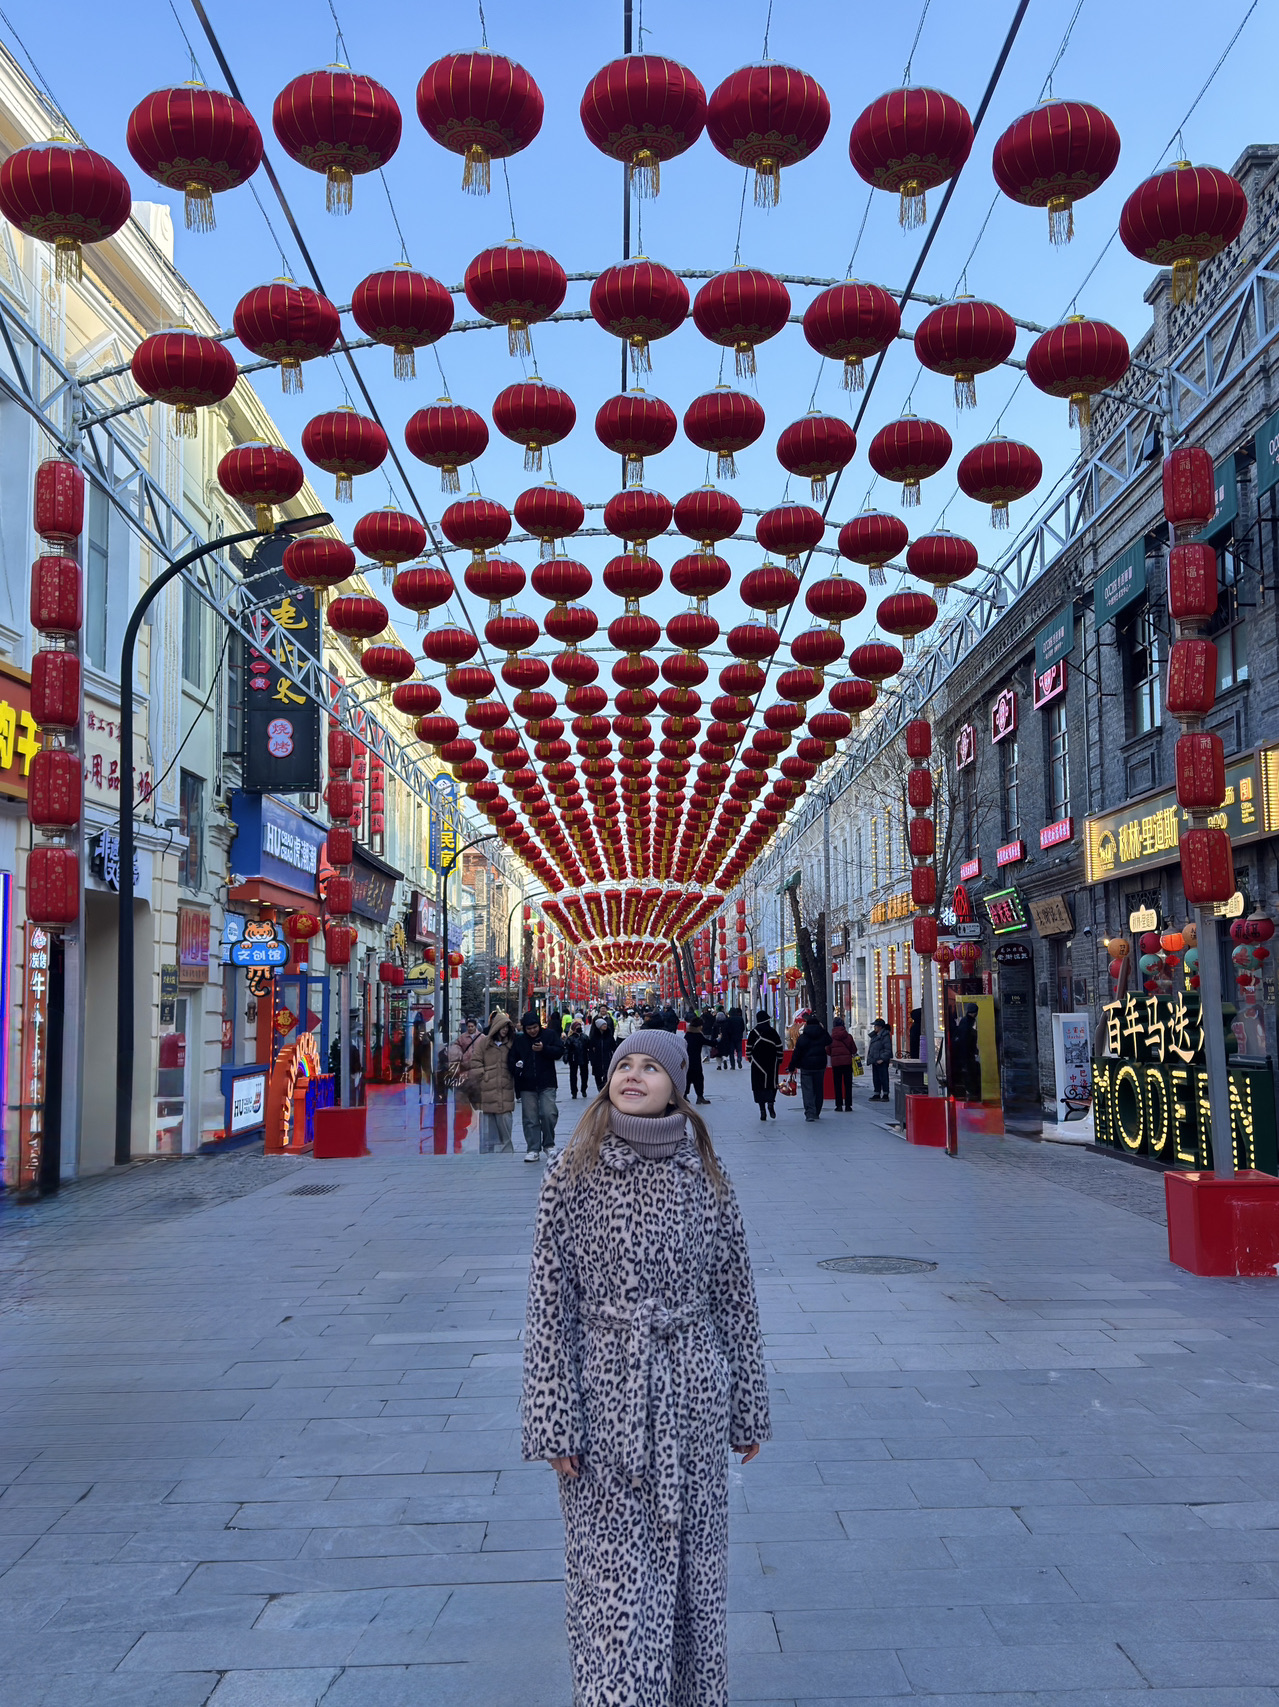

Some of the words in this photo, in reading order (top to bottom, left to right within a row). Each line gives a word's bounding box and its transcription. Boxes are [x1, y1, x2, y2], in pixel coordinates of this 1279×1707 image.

[272, 723, 291, 754] 烧烤
[266, 822, 281, 857] HU
[237, 949, 281, 961] 文创馆
